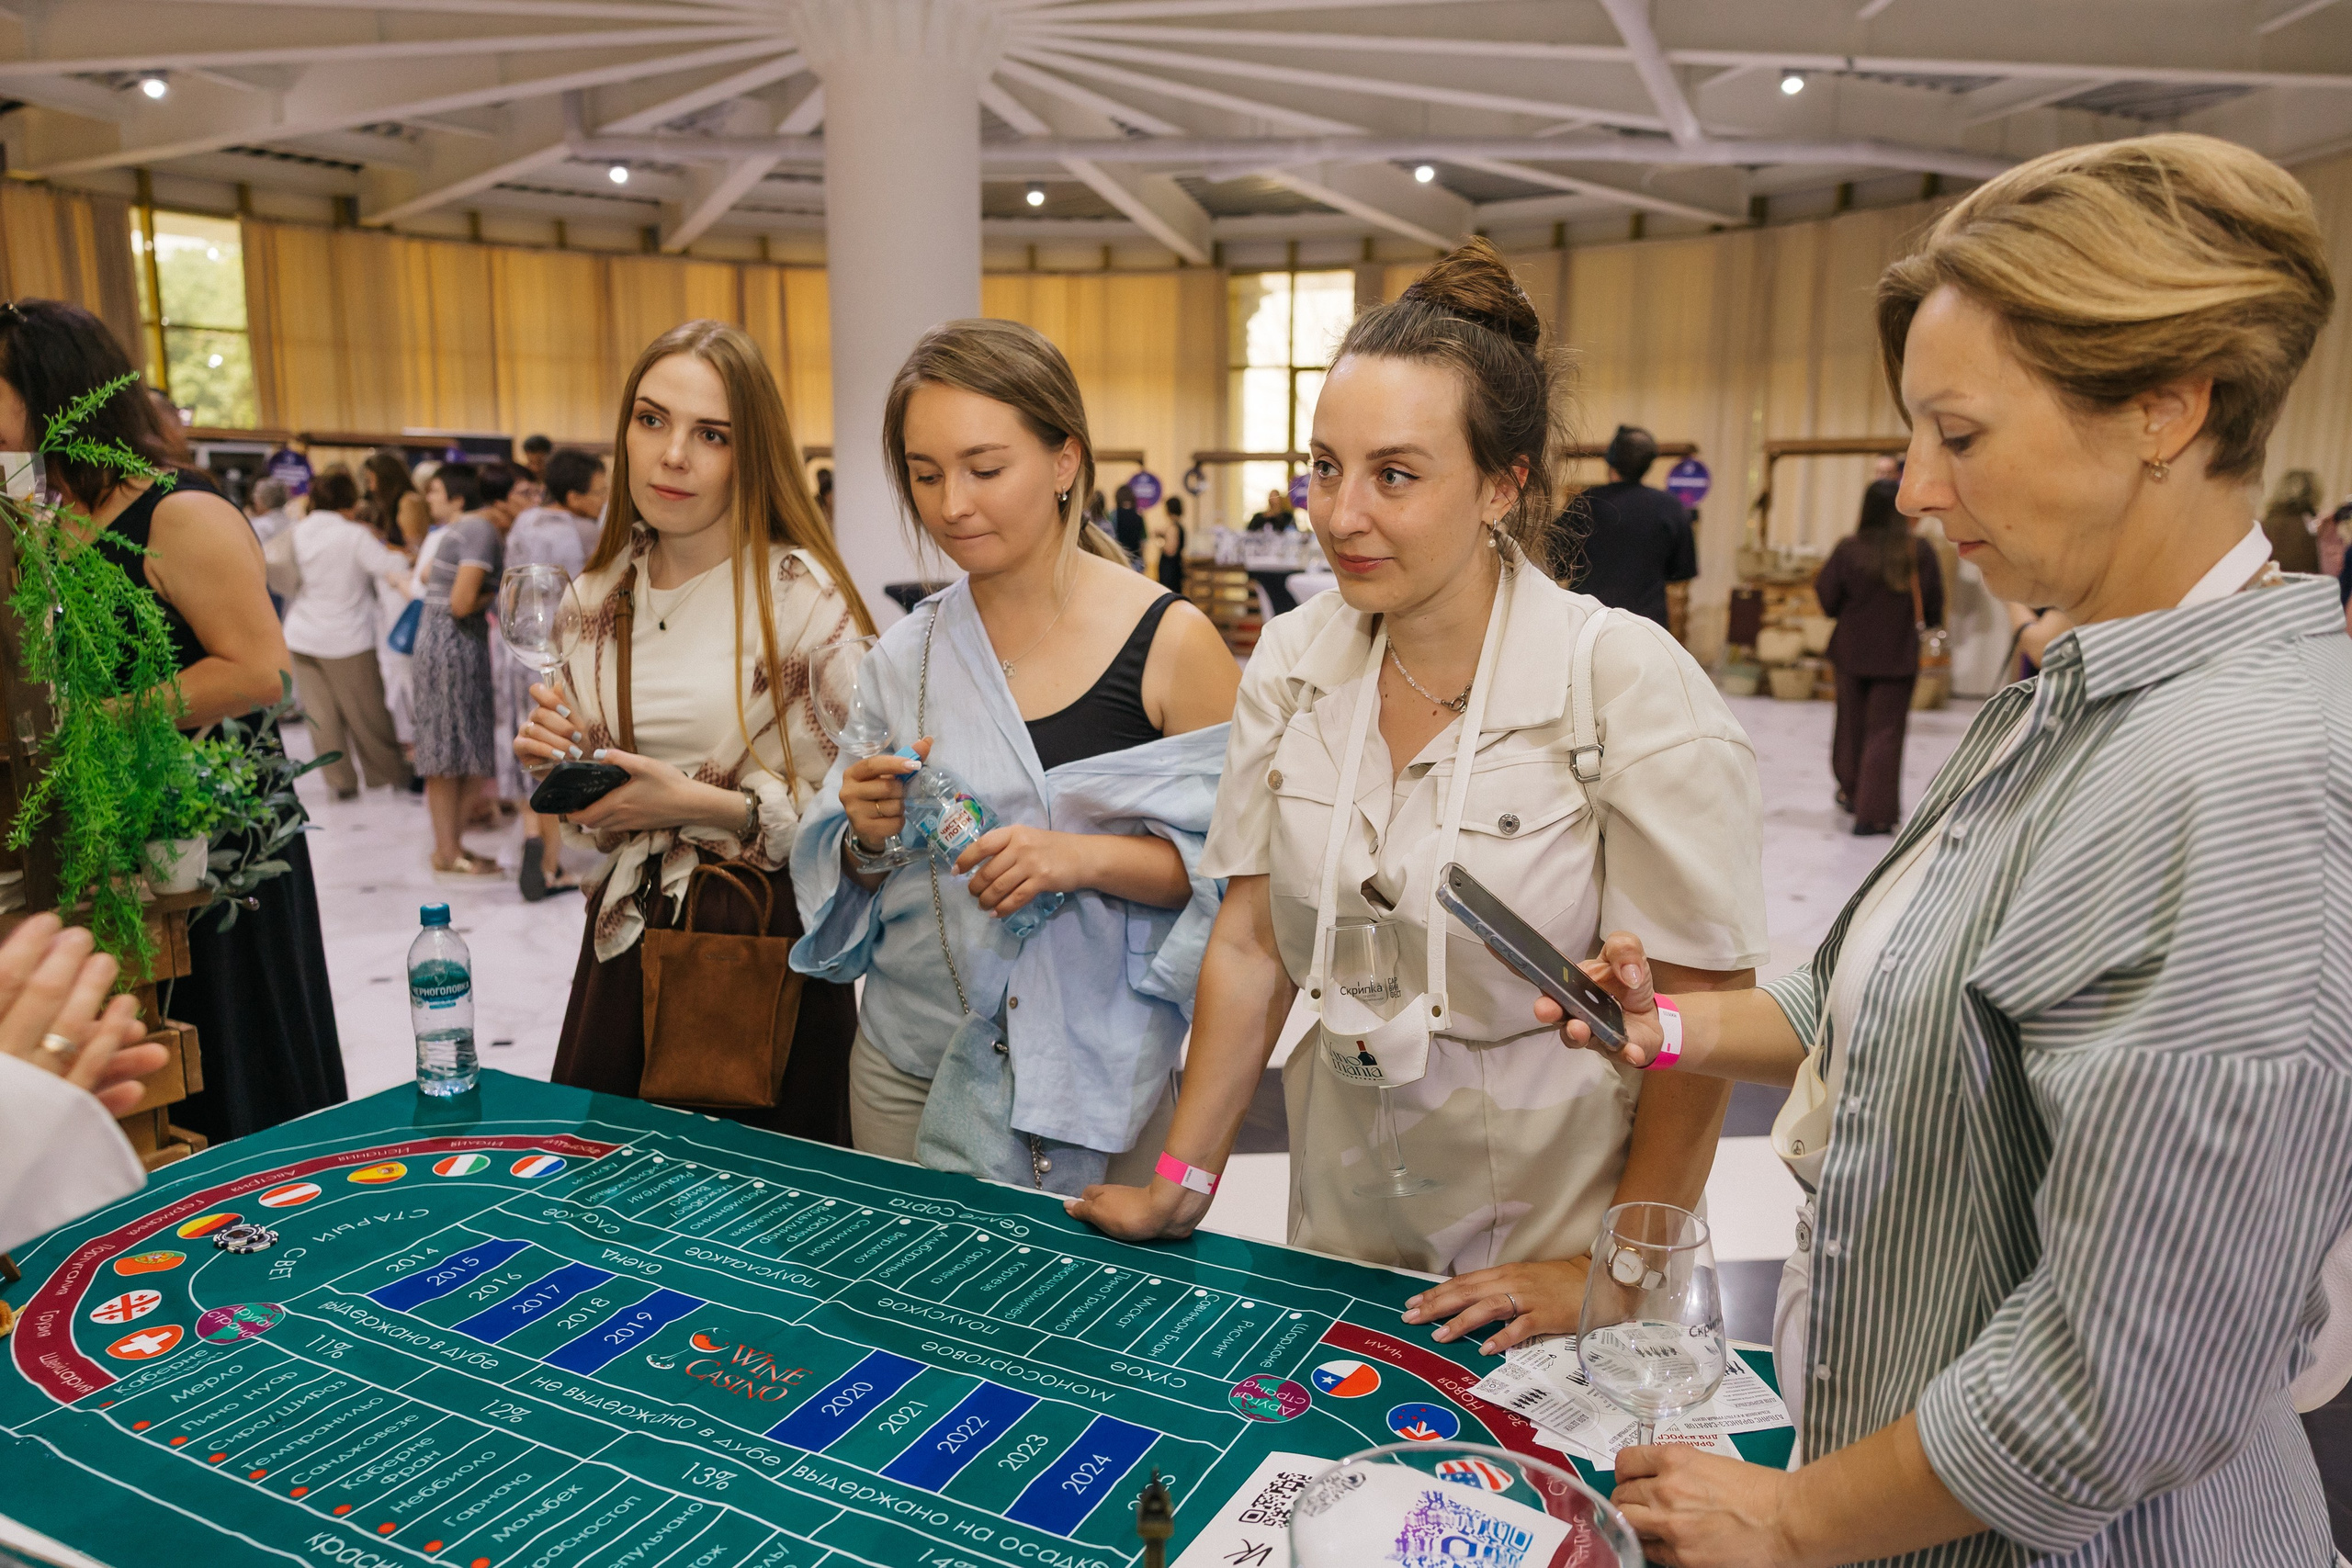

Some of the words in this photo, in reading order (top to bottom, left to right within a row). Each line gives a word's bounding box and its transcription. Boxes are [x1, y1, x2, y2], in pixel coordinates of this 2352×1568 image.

[126, 1198, 205, 1236] Германия
[312, 1208, 429, 1243] СТАРЫЙ
[888, 1198, 955, 1219] сорта
[807, 1219, 871, 1257] Семильон
[854, 1231, 907, 1264] Вердехо
[878, 1231, 949, 1279] Альбариньо
[268, 1247, 307, 1280] СВЕТ
[386, 1247, 439, 1272] 2014
[426, 1257, 480, 1286] 2015
[601, 1247, 663, 1275] бленд
[684, 1246, 820, 1289] полусладкое
[930, 1247, 991, 1285] Гарганега
[979, 1261, 1029, 1292] Кортезе
[469, 1272, 523, 1302] 2016
[512, 1284, 560, 1314] 2017
[1099, 1271, 1132, 1294] Пино
[208, 1310, 255, 1338] страна
[557, 1297, 611, 1330] 2018
[877, 1297, 1001, 1336] полусухое
[1055, 1287, 1108, 1332] Гриджио
[1115, 1295, 1157, 1329] Мускат
[305, 1334, 354, 1359] 11%
[317, 1300, 431, 1346] выдержано
[428, 1339, 446, 1351] в
[439, 1345, 500, 1371] дубе
[604, 1311, 653, 1346] 2019
[1148, 1334, 1180, 1358] Блан
[1211, 1320, 1255, 1359] Рислинг
[1260, 1323, 1309, 1368] Шардоне
[113, 1349, 209, 1394] Каберне
[684, 1359, 788, 1403] CASINO
[730, 1344, 813, 1385] WINE
[921, 1341, 1116, 1403] моносортовое
[1110, 1361, 1187, 1389] сухое
[170, 1364, 243, 1404] Мерло
[180, 1402, 240, 1431] Пино
[243, 1371, 298, 1401] Нуар
[820, 1382, 874, 1417] 2020
[1242, 1381, 1306, 1406] страна
[1437, 1376, 1485, 1412] Новая
[479, 1399, 533, 1424] 12%
[530, 1376, 563, 1393] не
[562, 1385, 697, 1430] выдержано
[697, 1427, 716, 1438] в
[712, 1438, 782, 1467] дубе
[877, 1400, 928, 1436] 2021
[1233, 1391, 1296, 1416] Другая
[241, 1397, 384, 1472] Темпранильо
[289, 1414, 419, 1484] Санджовезе
[937, 1416, 989, 1453] 2022
[998, 1434, 1049, 1472] 2023
[339, 1437, 435, 1490] Каберне
[379, 1450, 442, 1484] Фран
[390, 1450, 497, 1514] Неббиоло
[681, 1461, 738, 1490] 13%
[1061, 1454, 1112, 1495] 2024
[442, 1472, 533, 1528] Гарнача
[491, 1483, 583, 1543] Мальбек
[792, 1465, 948, 1527] выдержано
[953, 1520, 995, 1542] на
[523, 1495, 641, 1568] расностоп
